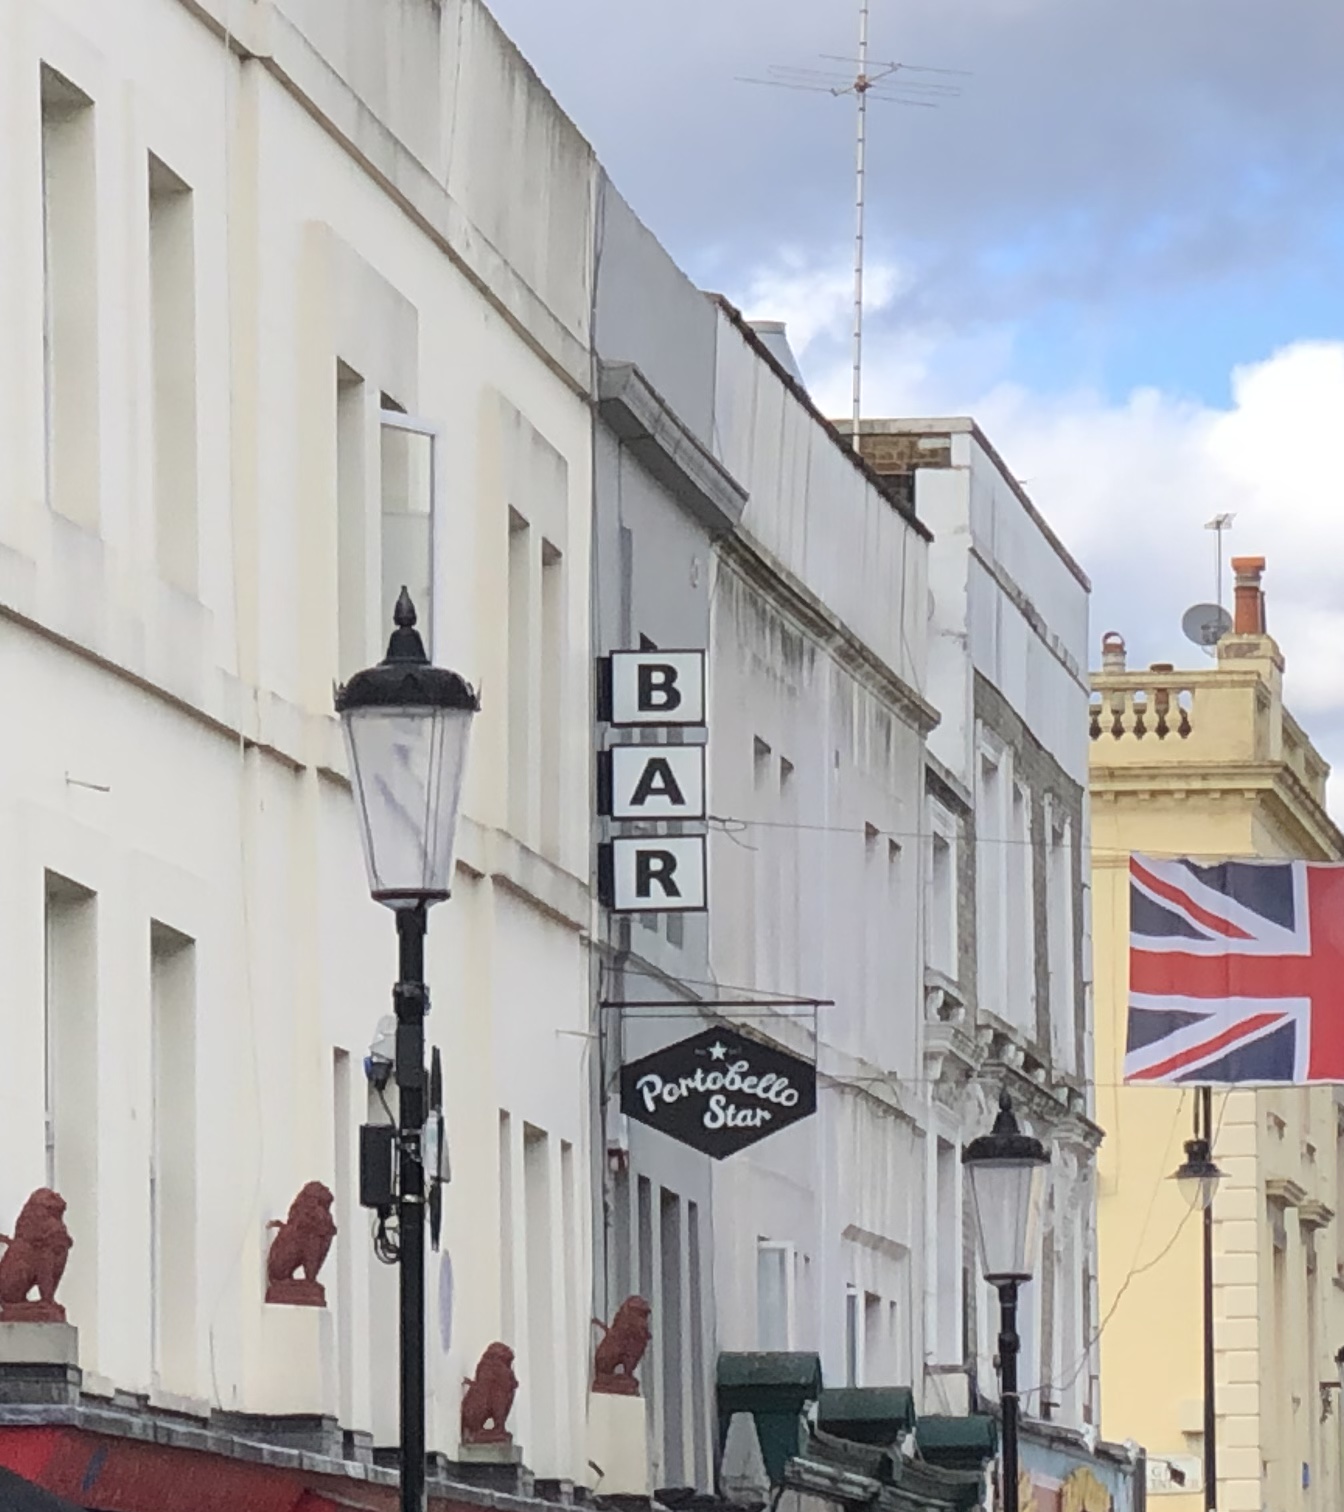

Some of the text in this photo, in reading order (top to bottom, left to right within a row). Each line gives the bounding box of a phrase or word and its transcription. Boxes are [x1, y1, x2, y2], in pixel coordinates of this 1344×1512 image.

[628, 663, 686, 898] BAR
[636, 1060, 798, 1112] Portobello
[704, 1094, 772, 1128] Star
